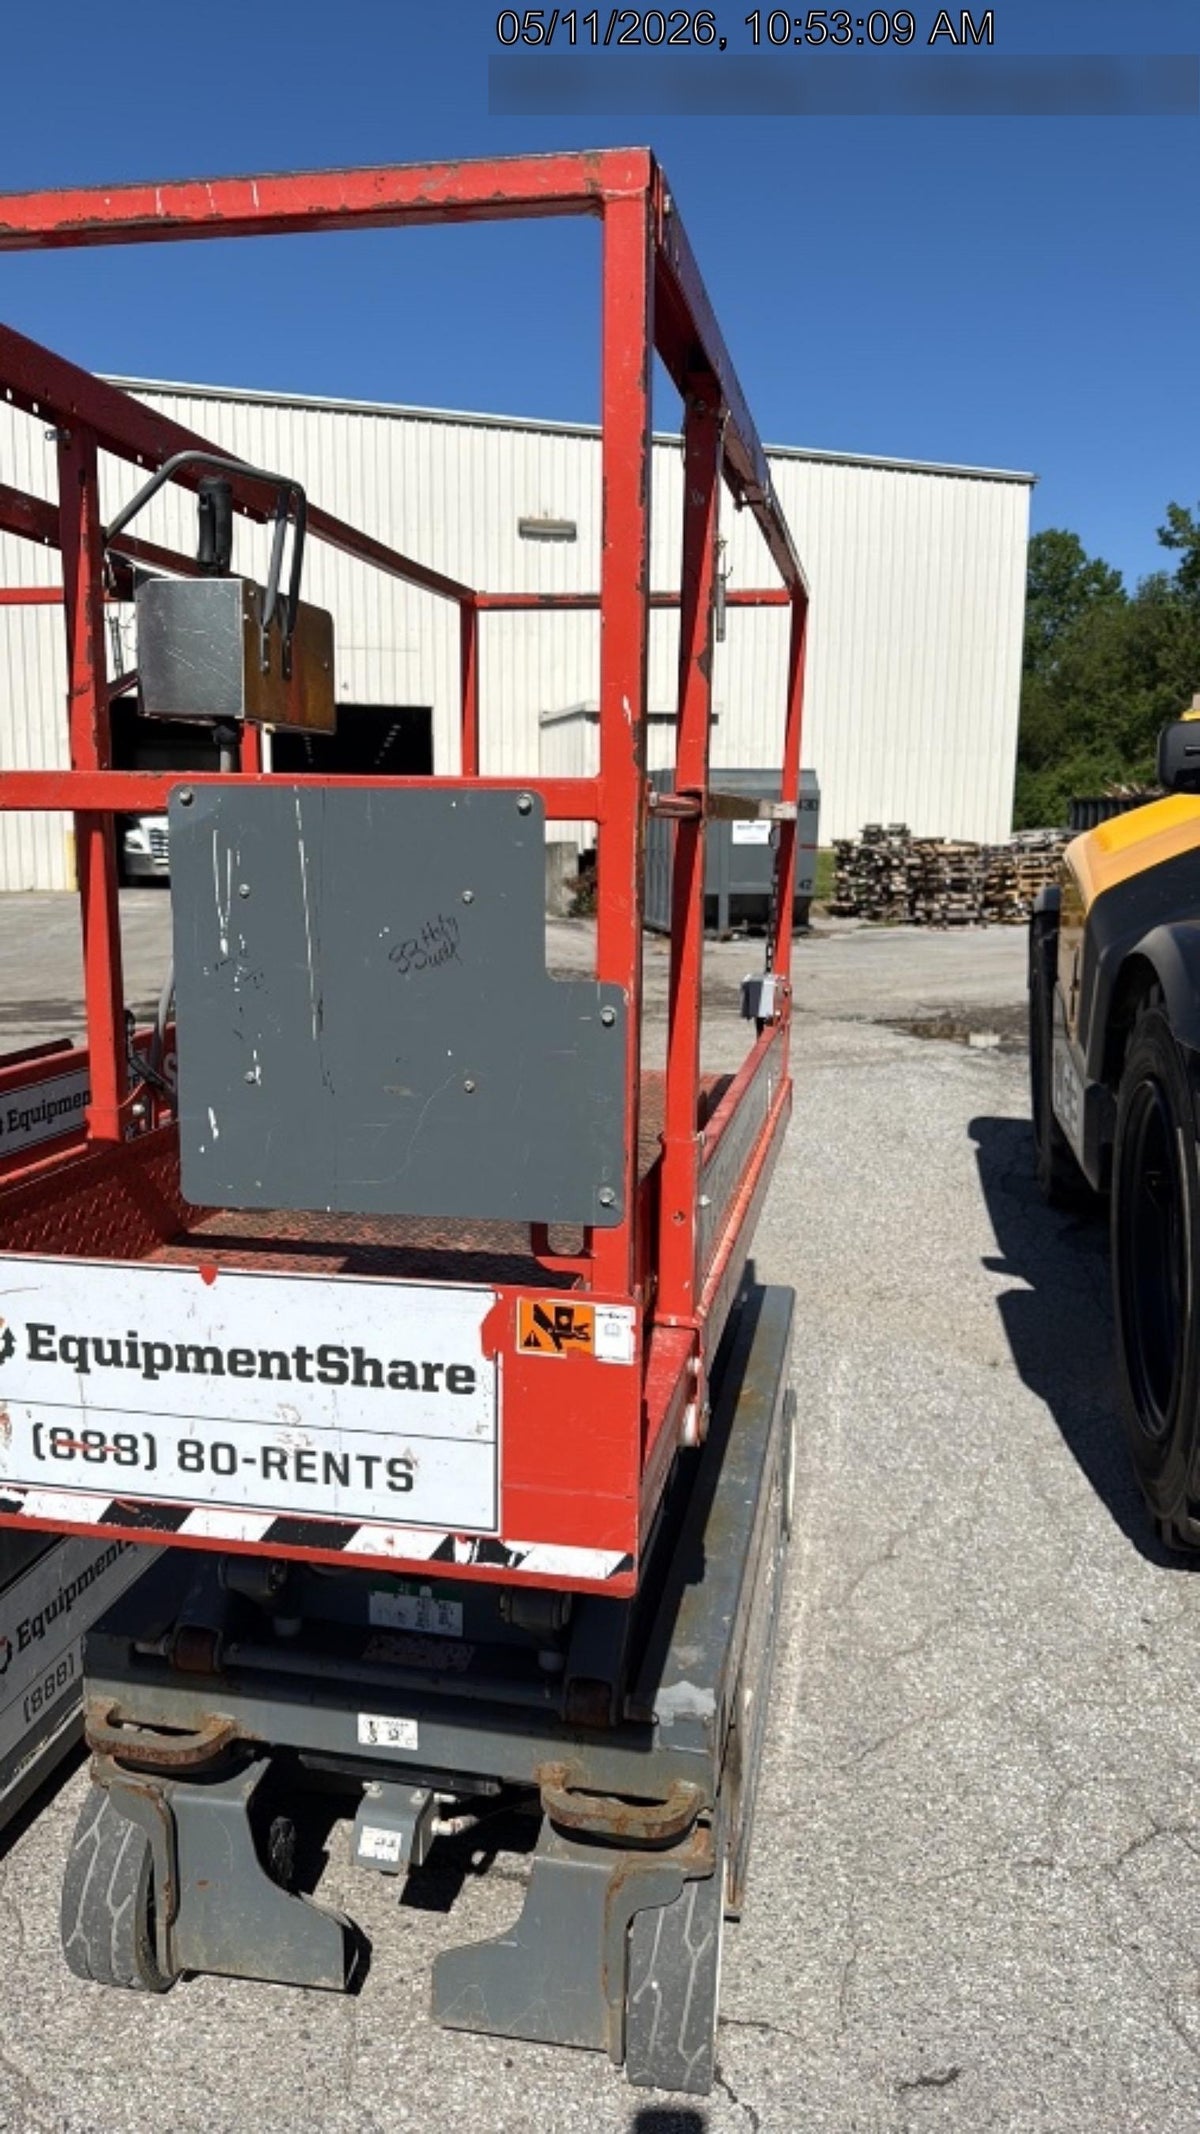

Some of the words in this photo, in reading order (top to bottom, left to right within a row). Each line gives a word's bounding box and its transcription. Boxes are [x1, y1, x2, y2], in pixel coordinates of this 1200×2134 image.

[7, 1090, 92, 1132] Equipmen
[25, 1322, 476, 1395] EquipmentShare
[32, 1422, 157, 1472] (888)
[177, 1438, 415, 1492] 80-RENTS
[16, 1539, 138, 1653] Equipment
